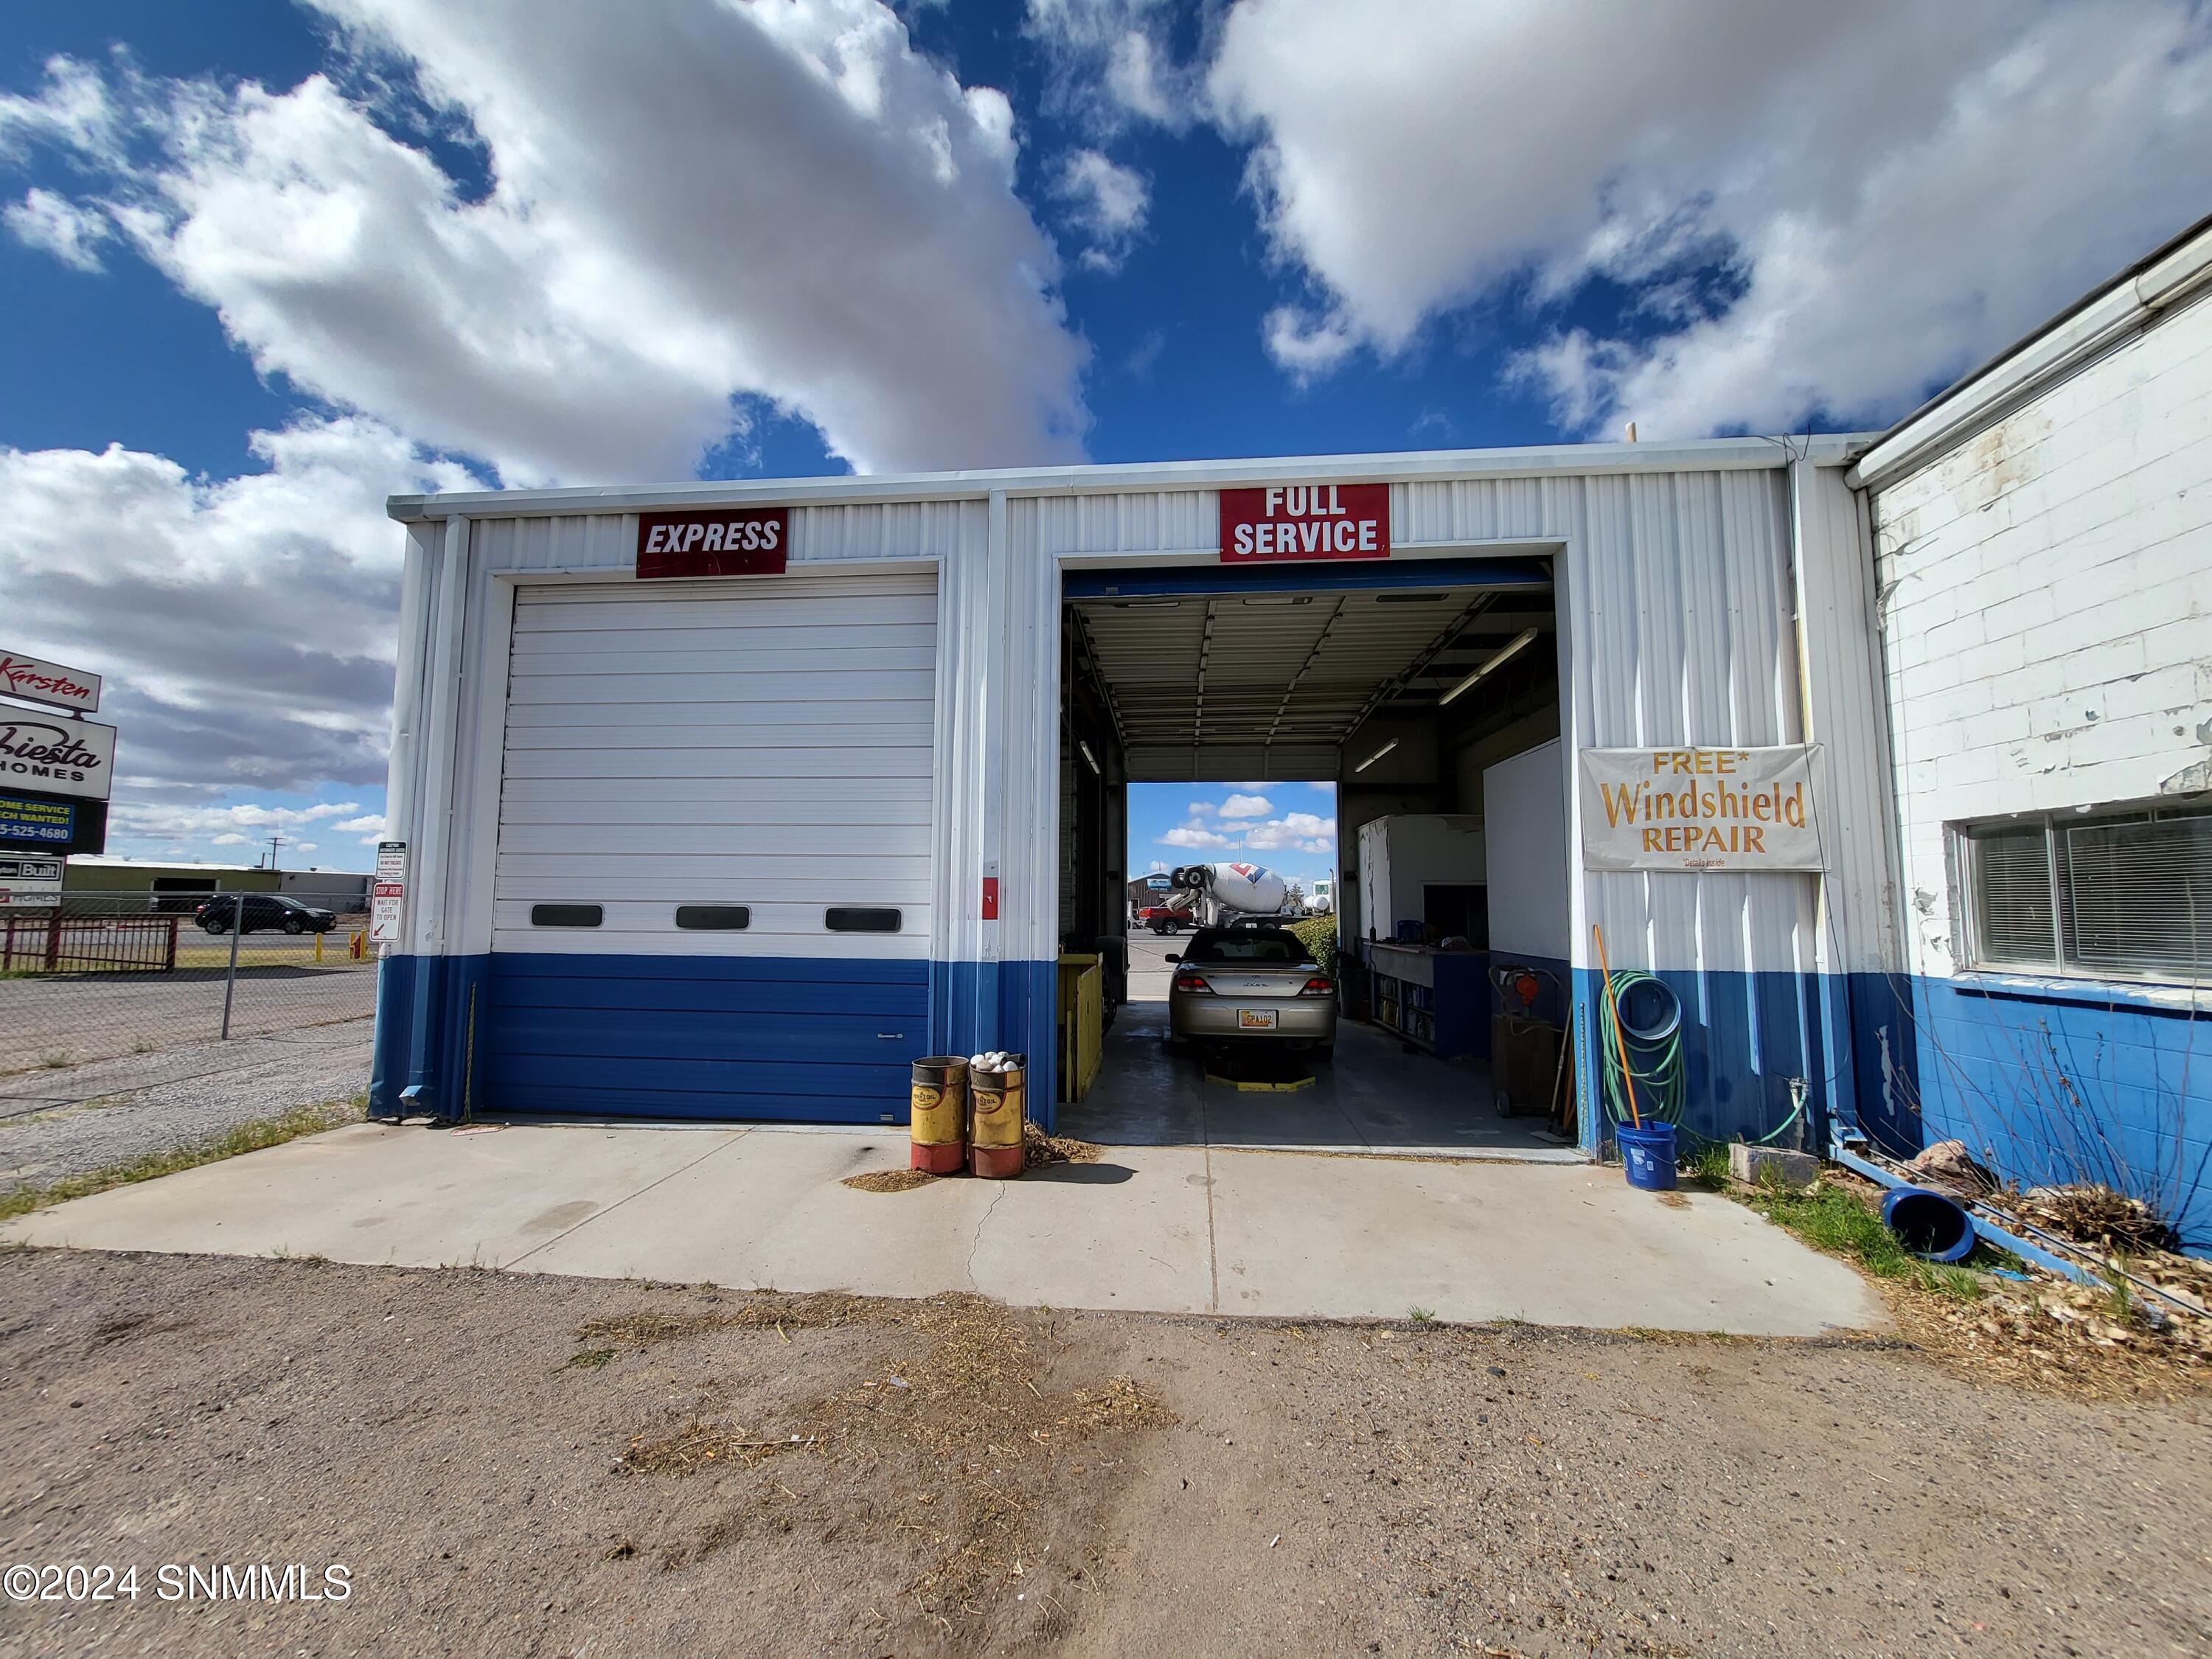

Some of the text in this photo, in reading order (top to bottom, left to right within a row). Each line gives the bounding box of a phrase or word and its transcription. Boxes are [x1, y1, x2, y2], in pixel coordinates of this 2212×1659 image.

[1265, 485, 1346, 516] FULL
[645, 521, 780, 553] EXPRESS
[1234, 520, 1377, 554] SERVICE
[0, 657, 90, 699] Karsten
[24, 803, 71, 815] SERVICE
[1600, 779, 1806, 828] Windshield
[20, 813, 69, 824] WANTED!
[1642, 826, 1767, 853] REPAIR
[22, 863, 57, 877] Built
[1706, 858, 1725, 867] Inside
[376, 886, 402, 894] STOP HERE
